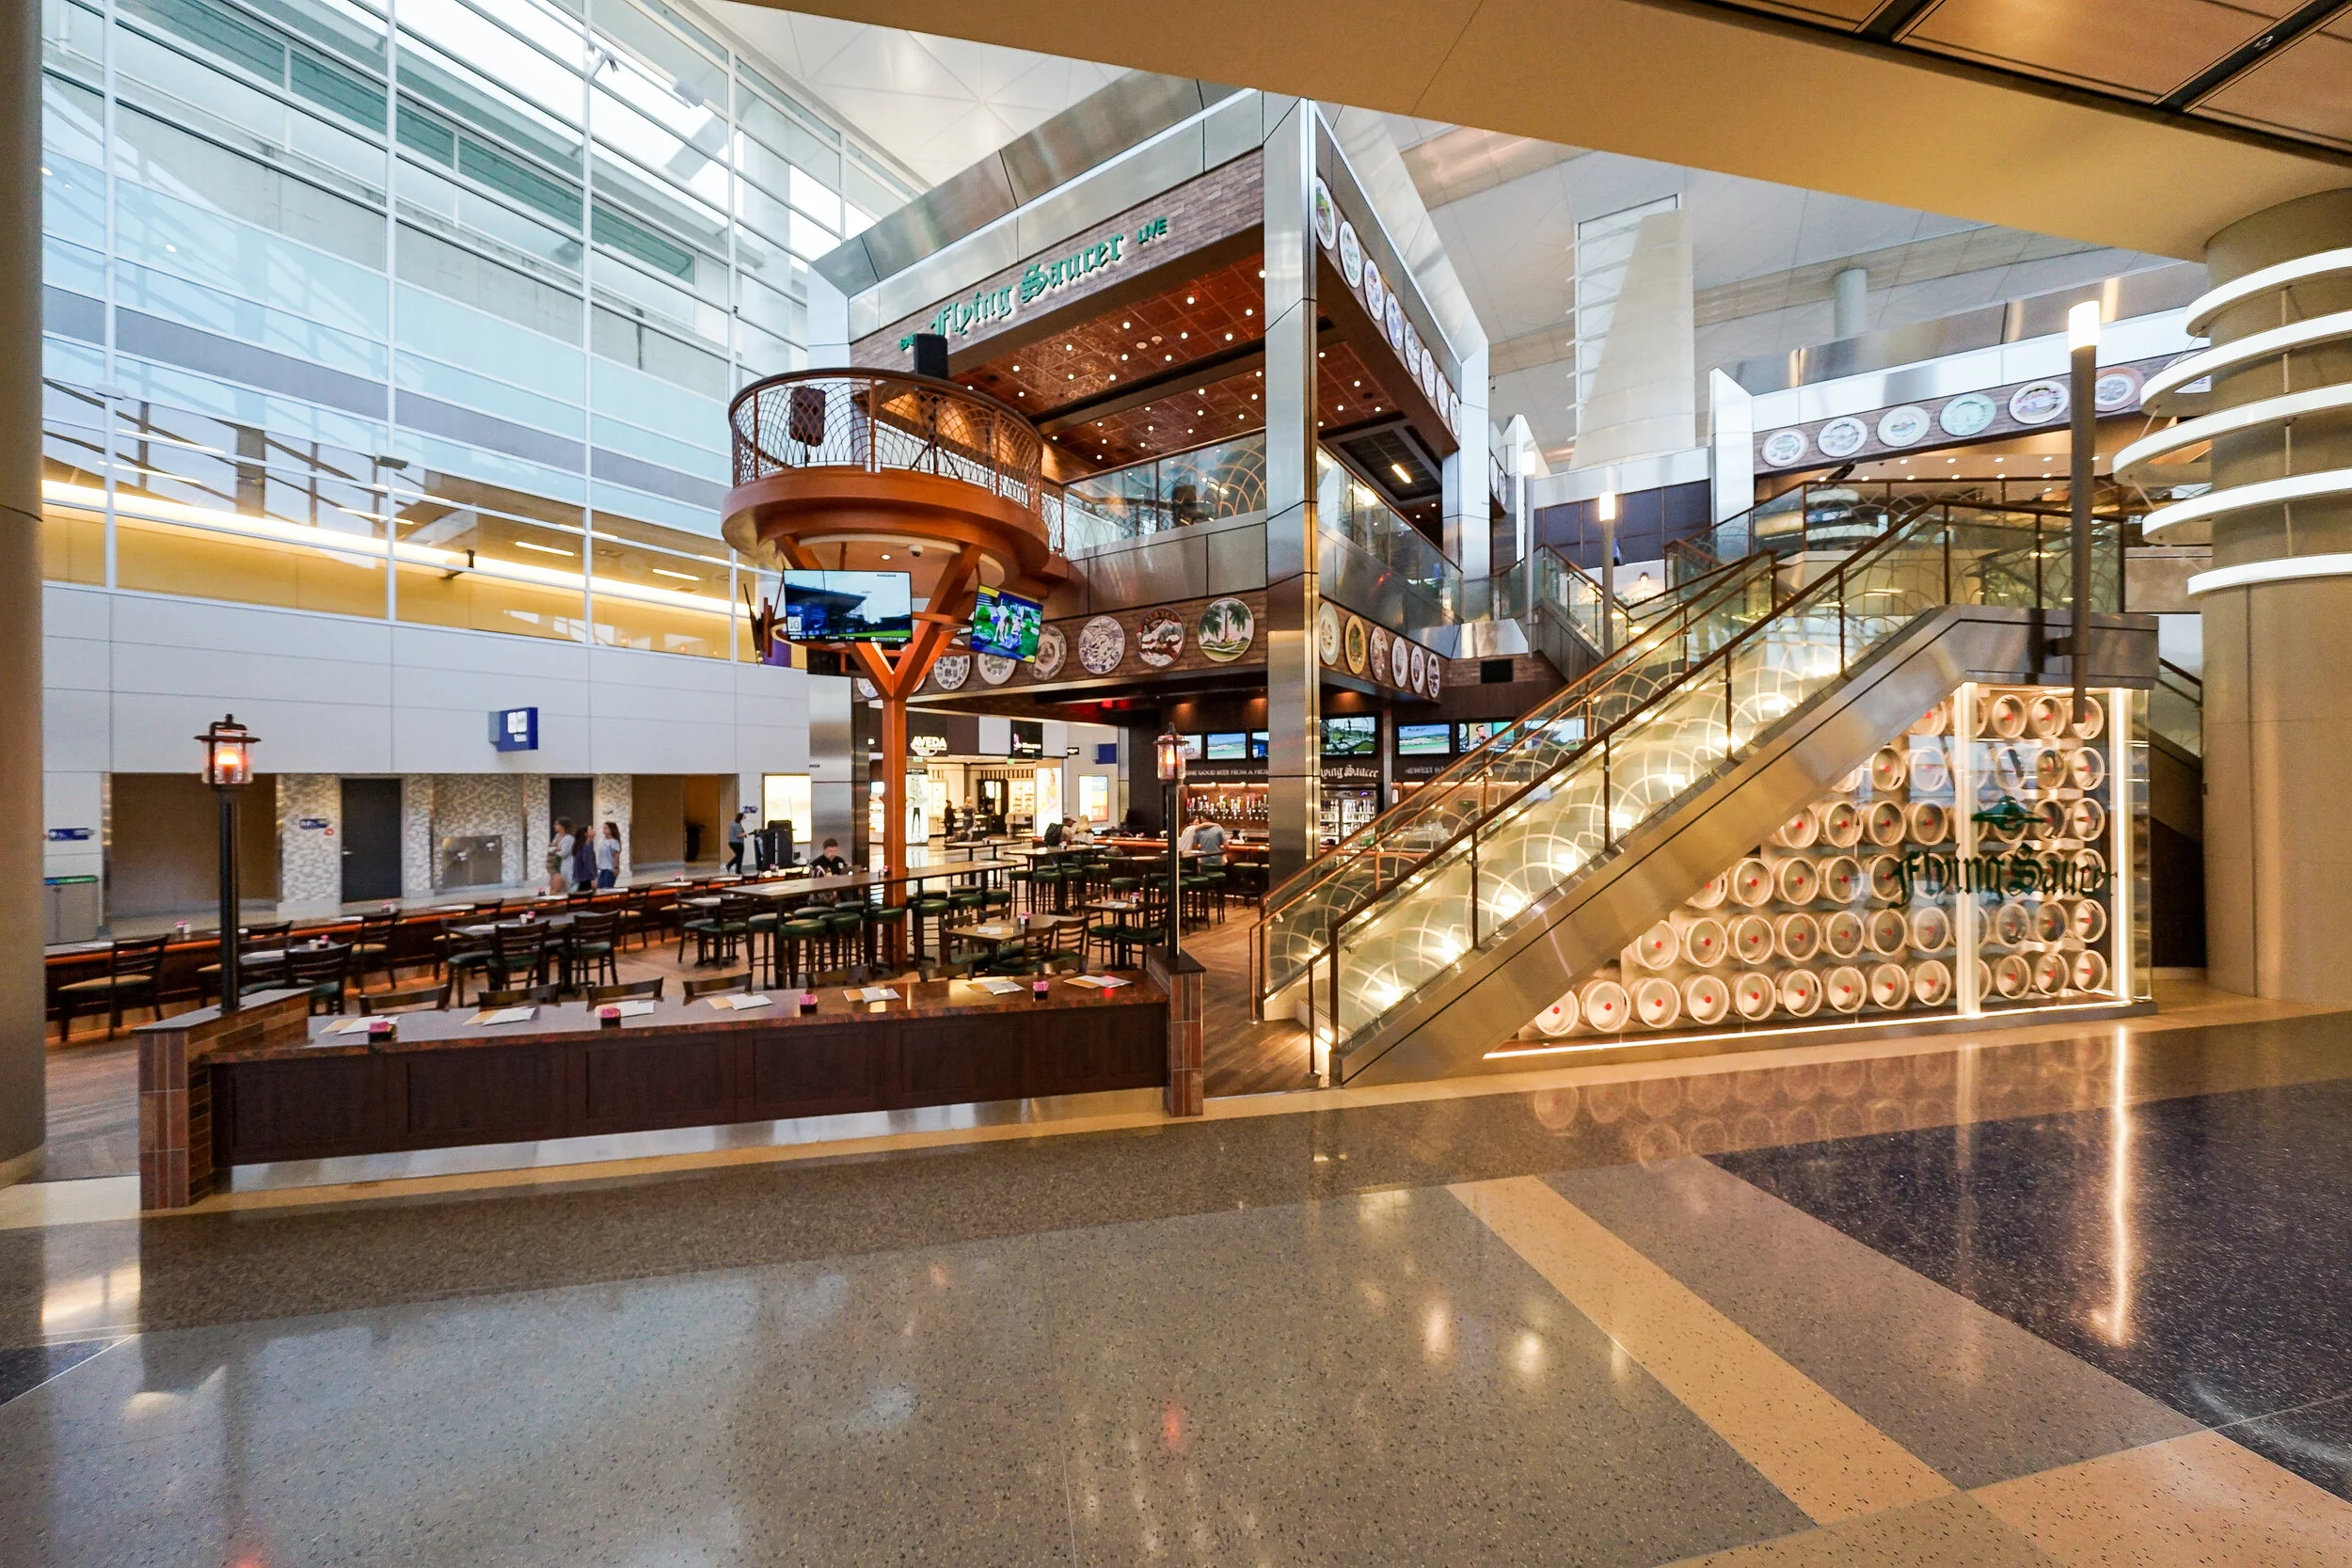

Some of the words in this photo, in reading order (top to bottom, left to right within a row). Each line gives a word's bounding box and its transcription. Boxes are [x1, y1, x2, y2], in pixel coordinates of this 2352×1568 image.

[930, 284, 1013, 337] Flying
[1020, 233, 1125, 304] Saucer
[1136, 216, 1168, 245] LIVE
[912, 736, 947, 749] AVEDA
